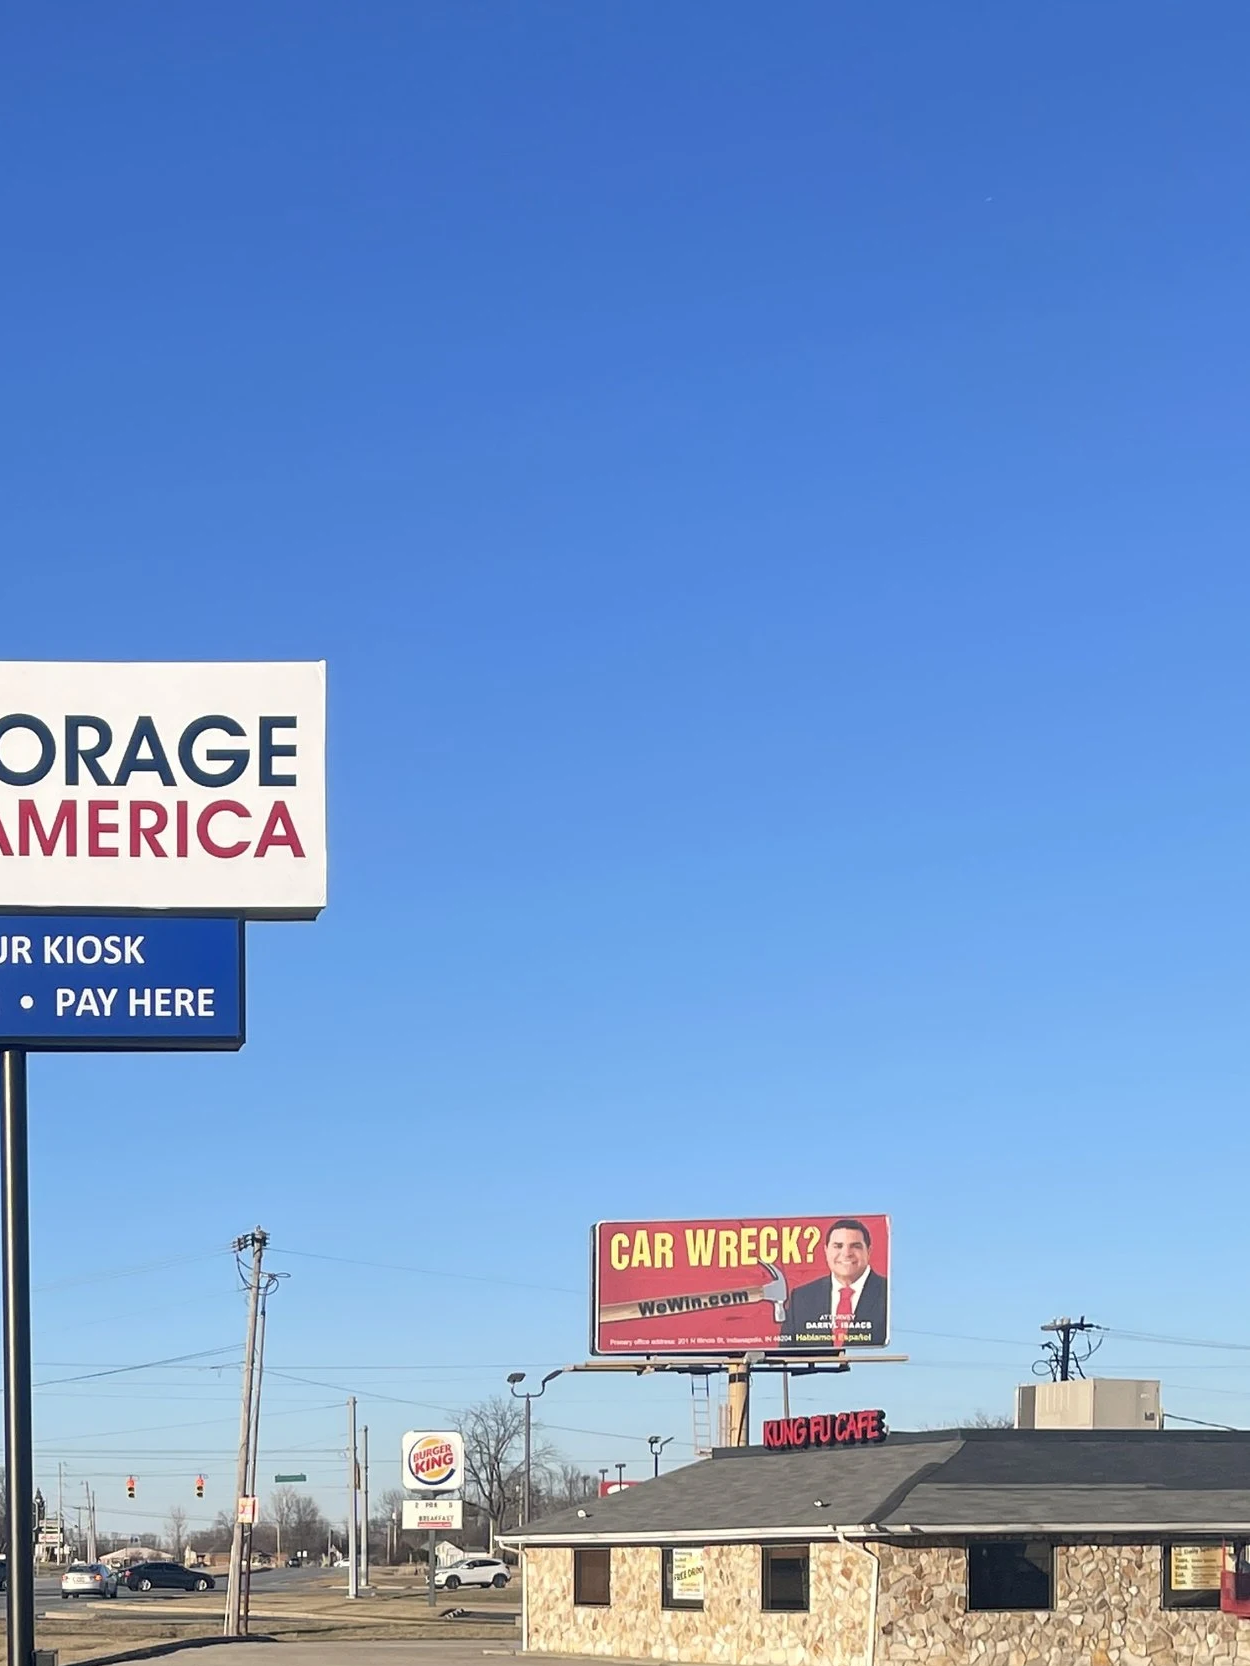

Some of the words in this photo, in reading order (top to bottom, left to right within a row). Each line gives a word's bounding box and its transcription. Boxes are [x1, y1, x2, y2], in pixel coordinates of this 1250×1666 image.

[44, 935, 145, 965] KIOSK
[56, 988, 118, 1017] PAY
[129, 988, 215, 1017] HERE
[611, 1230, 674, 1270] CAR
[685, 1226, 821, 1268] WRECK?
[763, 1417, 808, 1448] KUNG
[810, 1414, 833, 1444] FU
[835, 1409, 881, 1442] CAFE
[413, 1443, 452, 1462] BURGER
[415, 1452, 453, 1475] KING
